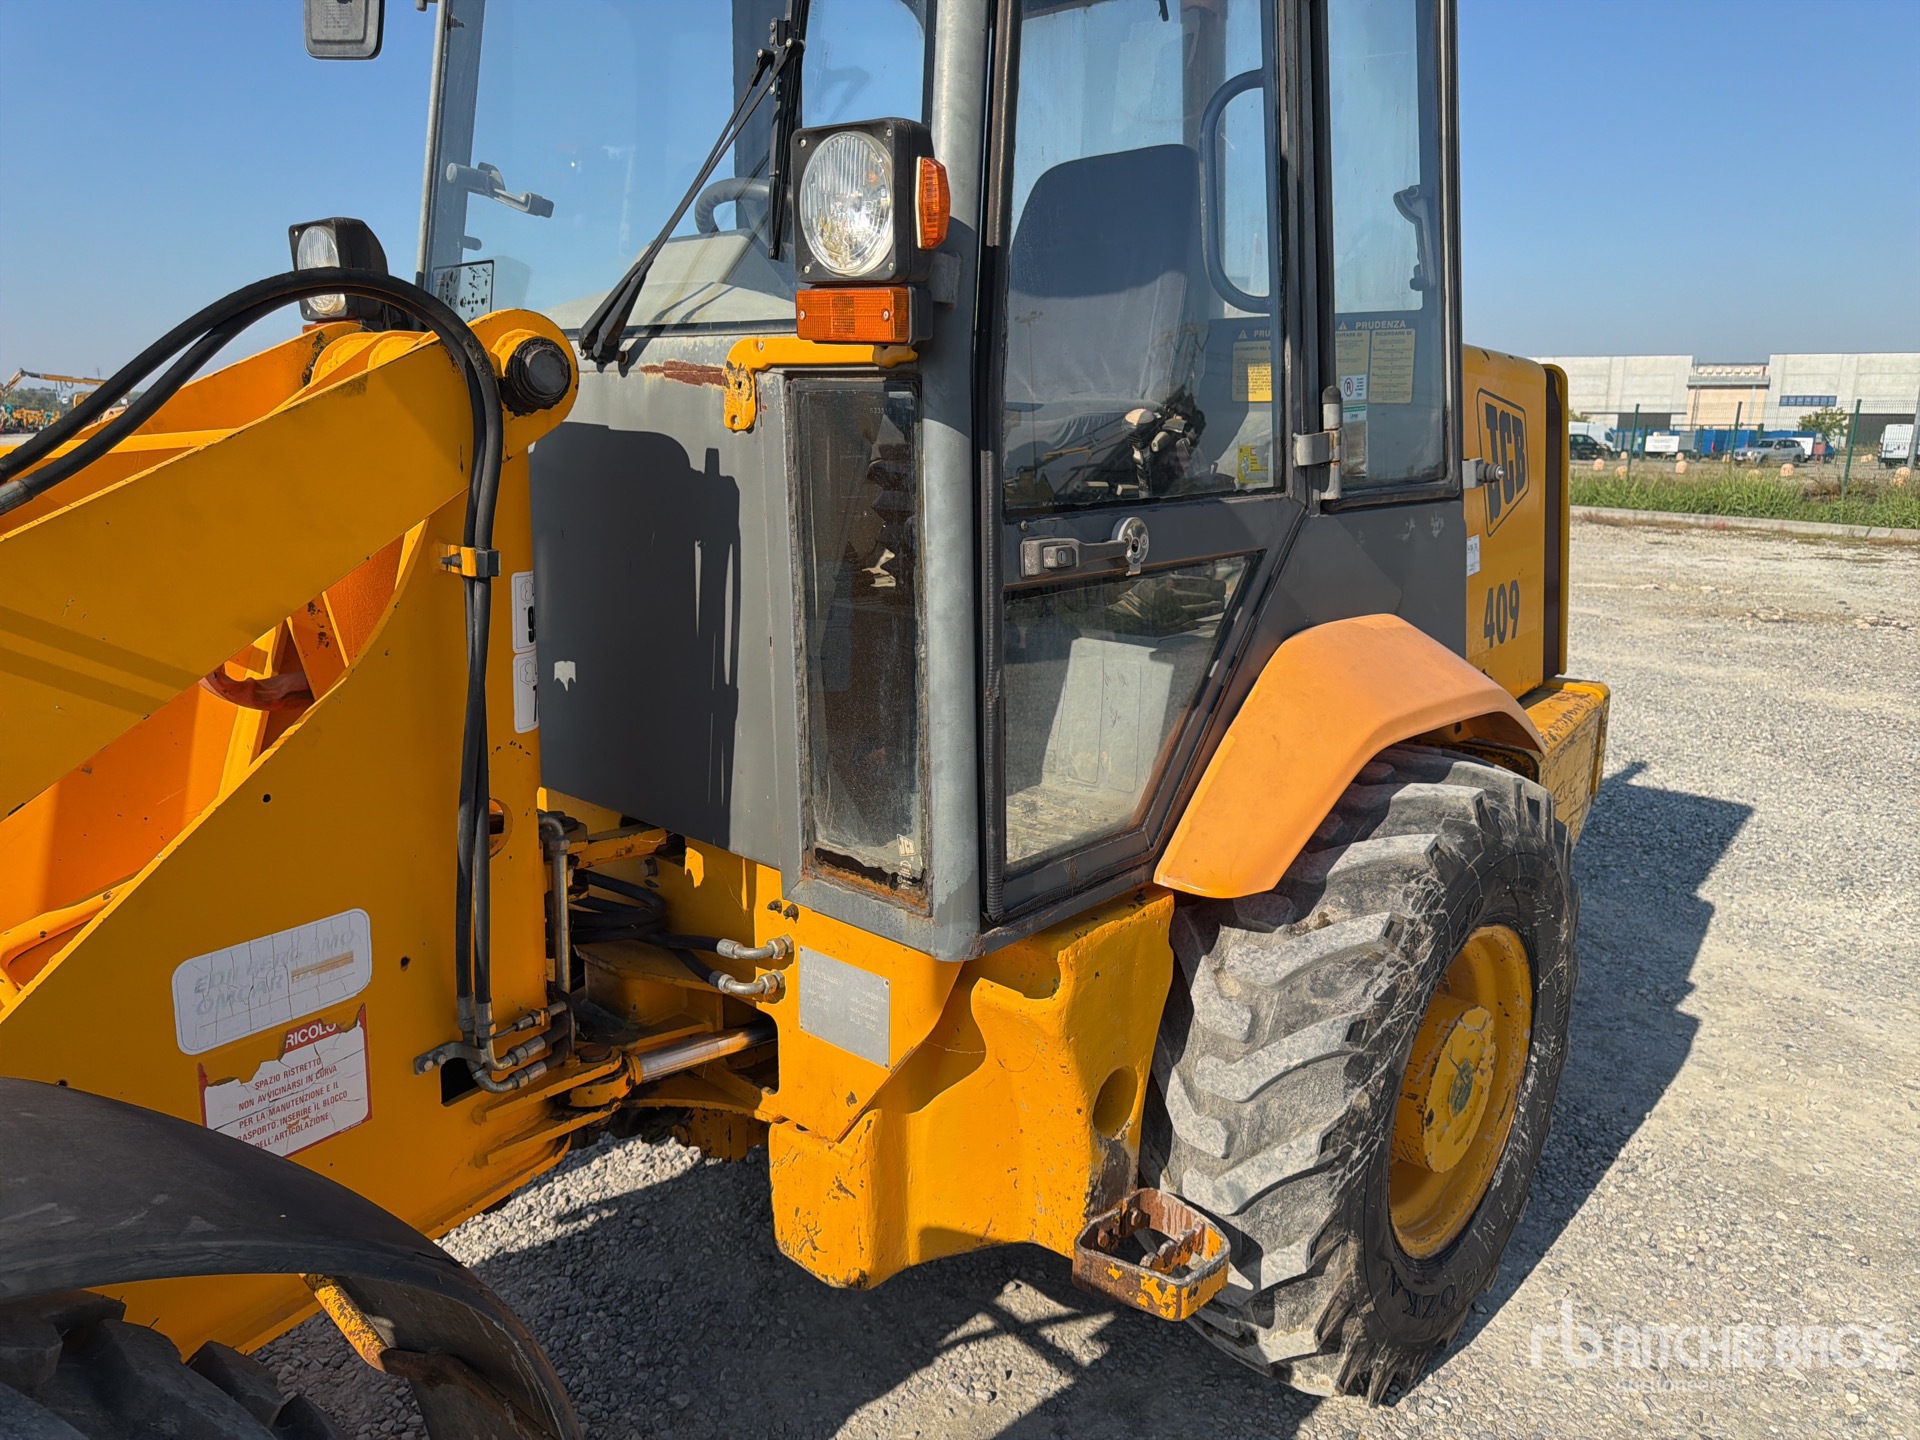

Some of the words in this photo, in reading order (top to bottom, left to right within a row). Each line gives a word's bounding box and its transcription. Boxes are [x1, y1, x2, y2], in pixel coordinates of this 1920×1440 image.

[1355, 320, 1406, 330] PRUDENZA
[1485, 402, 1526, 525] JCB
[1484, 579, 1519, 648] 409
[239, 1098, 254, 1111] NON
[258, 1079, 303, 1103] AVVICINARSI
[306, 1075, 313, 1085] IN
[316, 1066, 337, 1080] CURVA
[255, 1074, 280, 1090] SPAZIO
[284, 1058, 321, 1079] RISTRETTO
[239, 1117, 253, 1128] PER
[256, 1112, 265, 1123] LA
[268, 1087, 324, 1116] MANUTENZIONE
[327, 1084, 330, 1092] E
[333, 1081, 339, 1089] IL
[280, 1107, 311, 1125] INSERIRE
[314, 1102, 320, 1110] IL
[323, 1091, 347, 1107] BLOCCO
